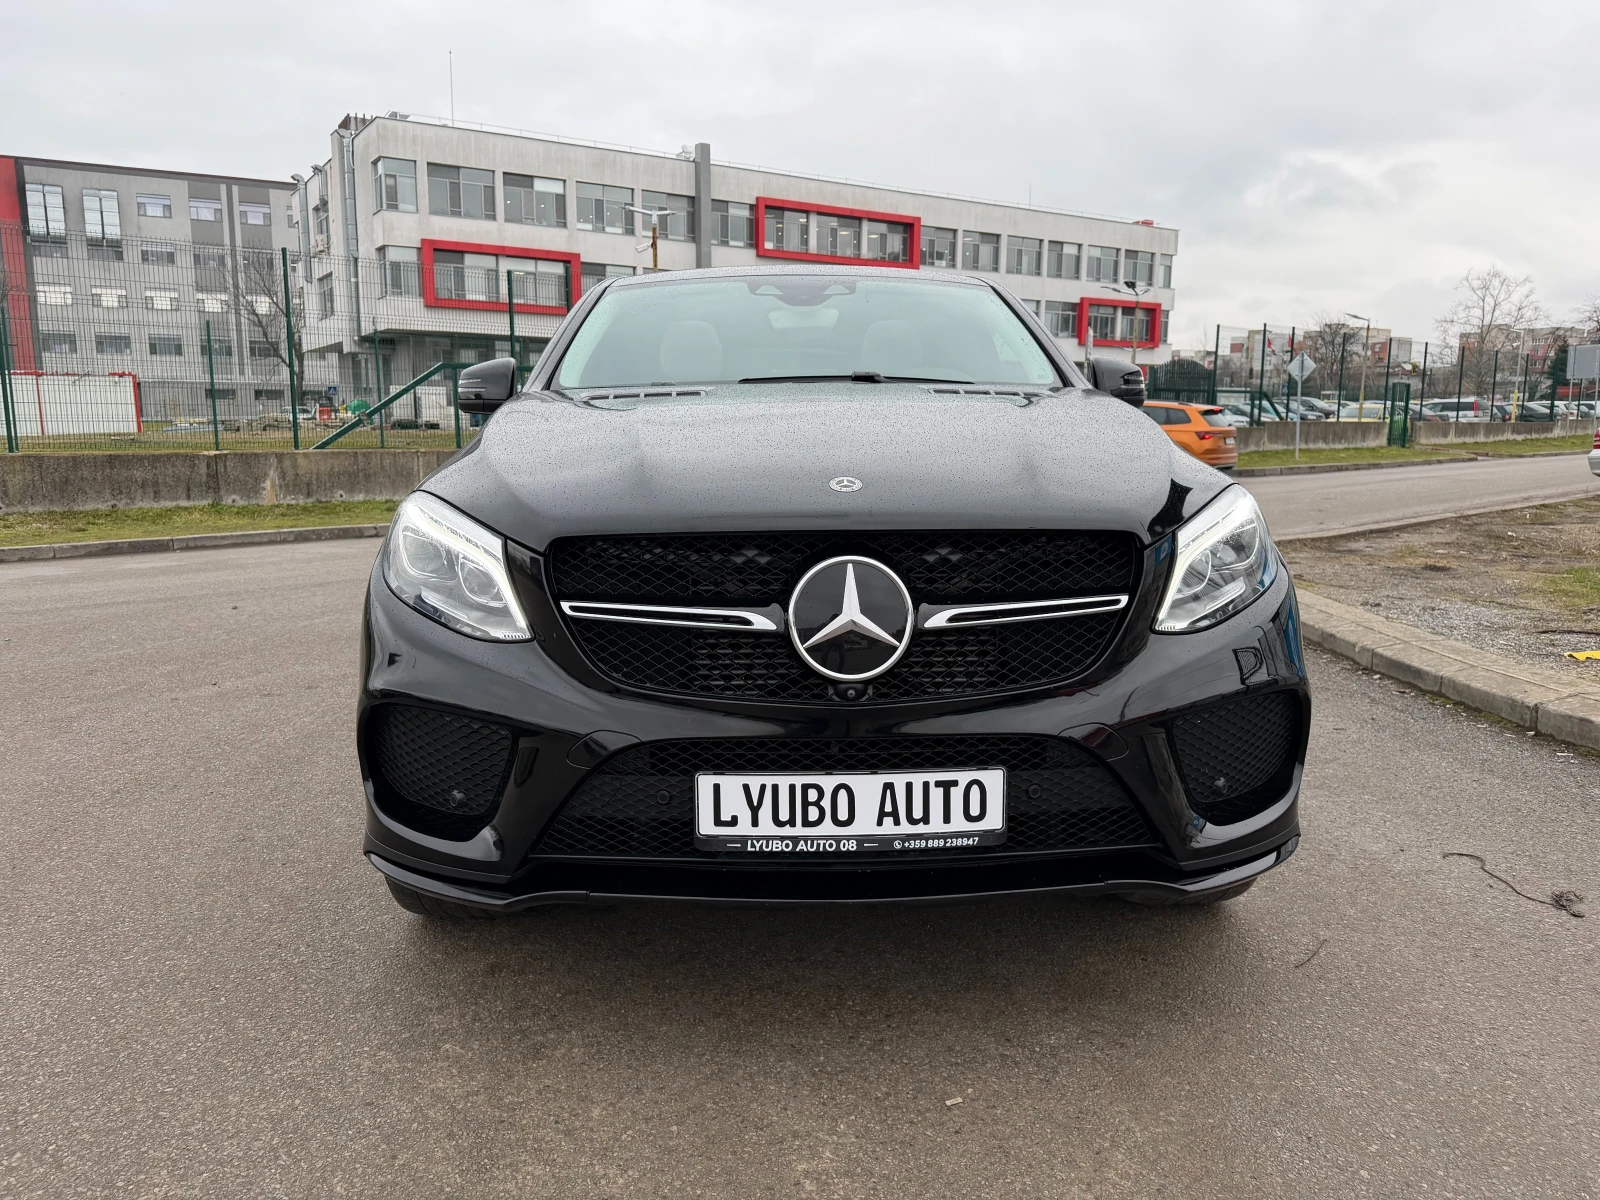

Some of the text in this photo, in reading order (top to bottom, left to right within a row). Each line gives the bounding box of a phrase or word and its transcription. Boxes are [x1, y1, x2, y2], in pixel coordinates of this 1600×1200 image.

[712, 778, 988, 828] LYUBO AUTO
[747, 839, 857, 852] LYUBO AUTO 08
[904, 837, 979, 849] +359 889 238947
